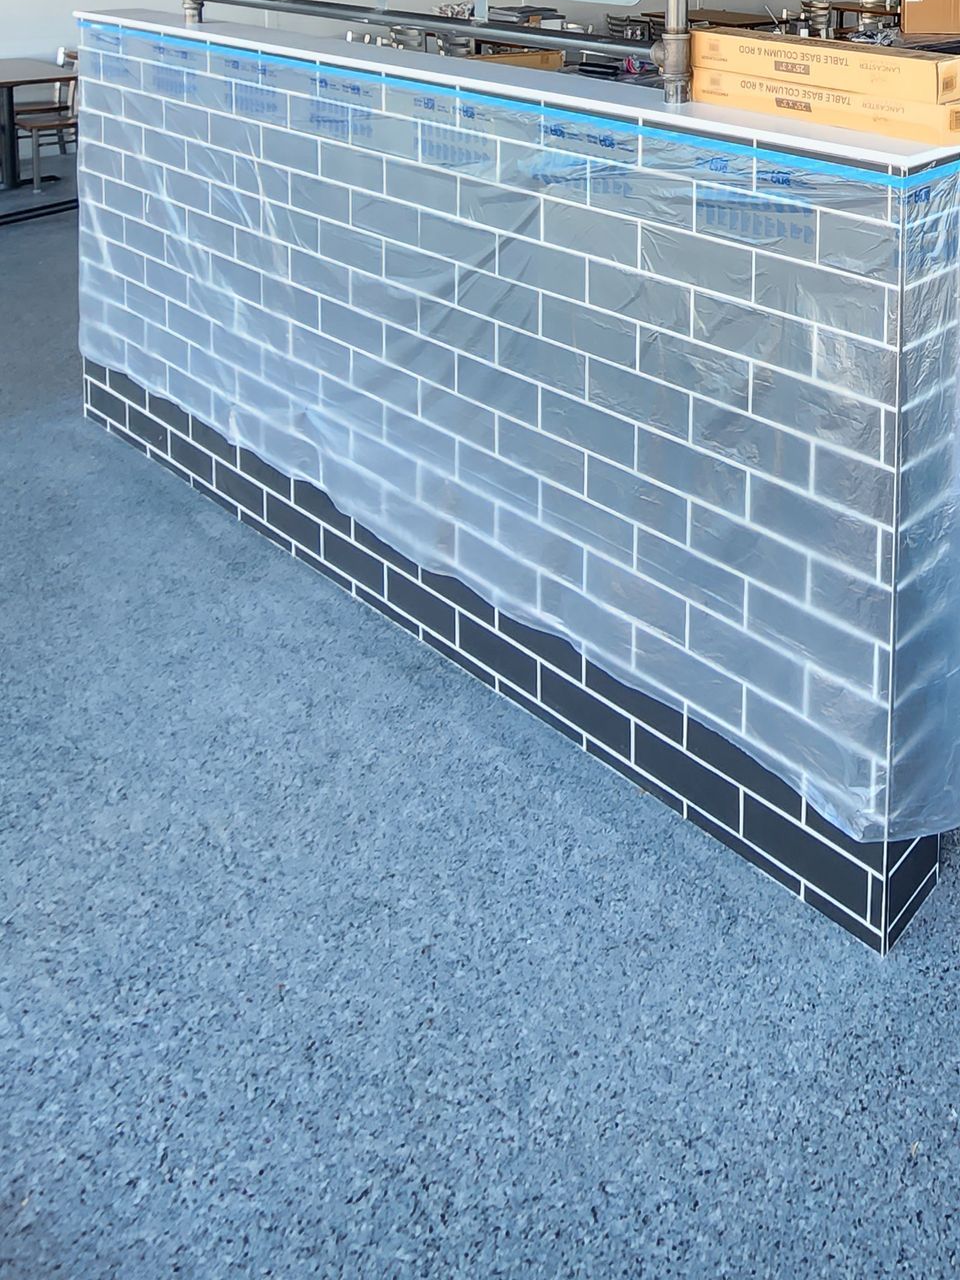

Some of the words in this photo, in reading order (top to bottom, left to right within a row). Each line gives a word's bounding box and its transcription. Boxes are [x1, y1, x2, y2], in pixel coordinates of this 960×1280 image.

[739, 45, 755, 55] ROD
[764, 47, 798, 60] COLUMN
[800, 52, 821, 63] BASE
[824, 56, 849, 66] TABLE
[740, 80, 757, 90] ROD
[765, 83, 800, 97] COLUMN
[802, 89, 823, 102] BASE
[825, 93, 851, 106] TABLE
